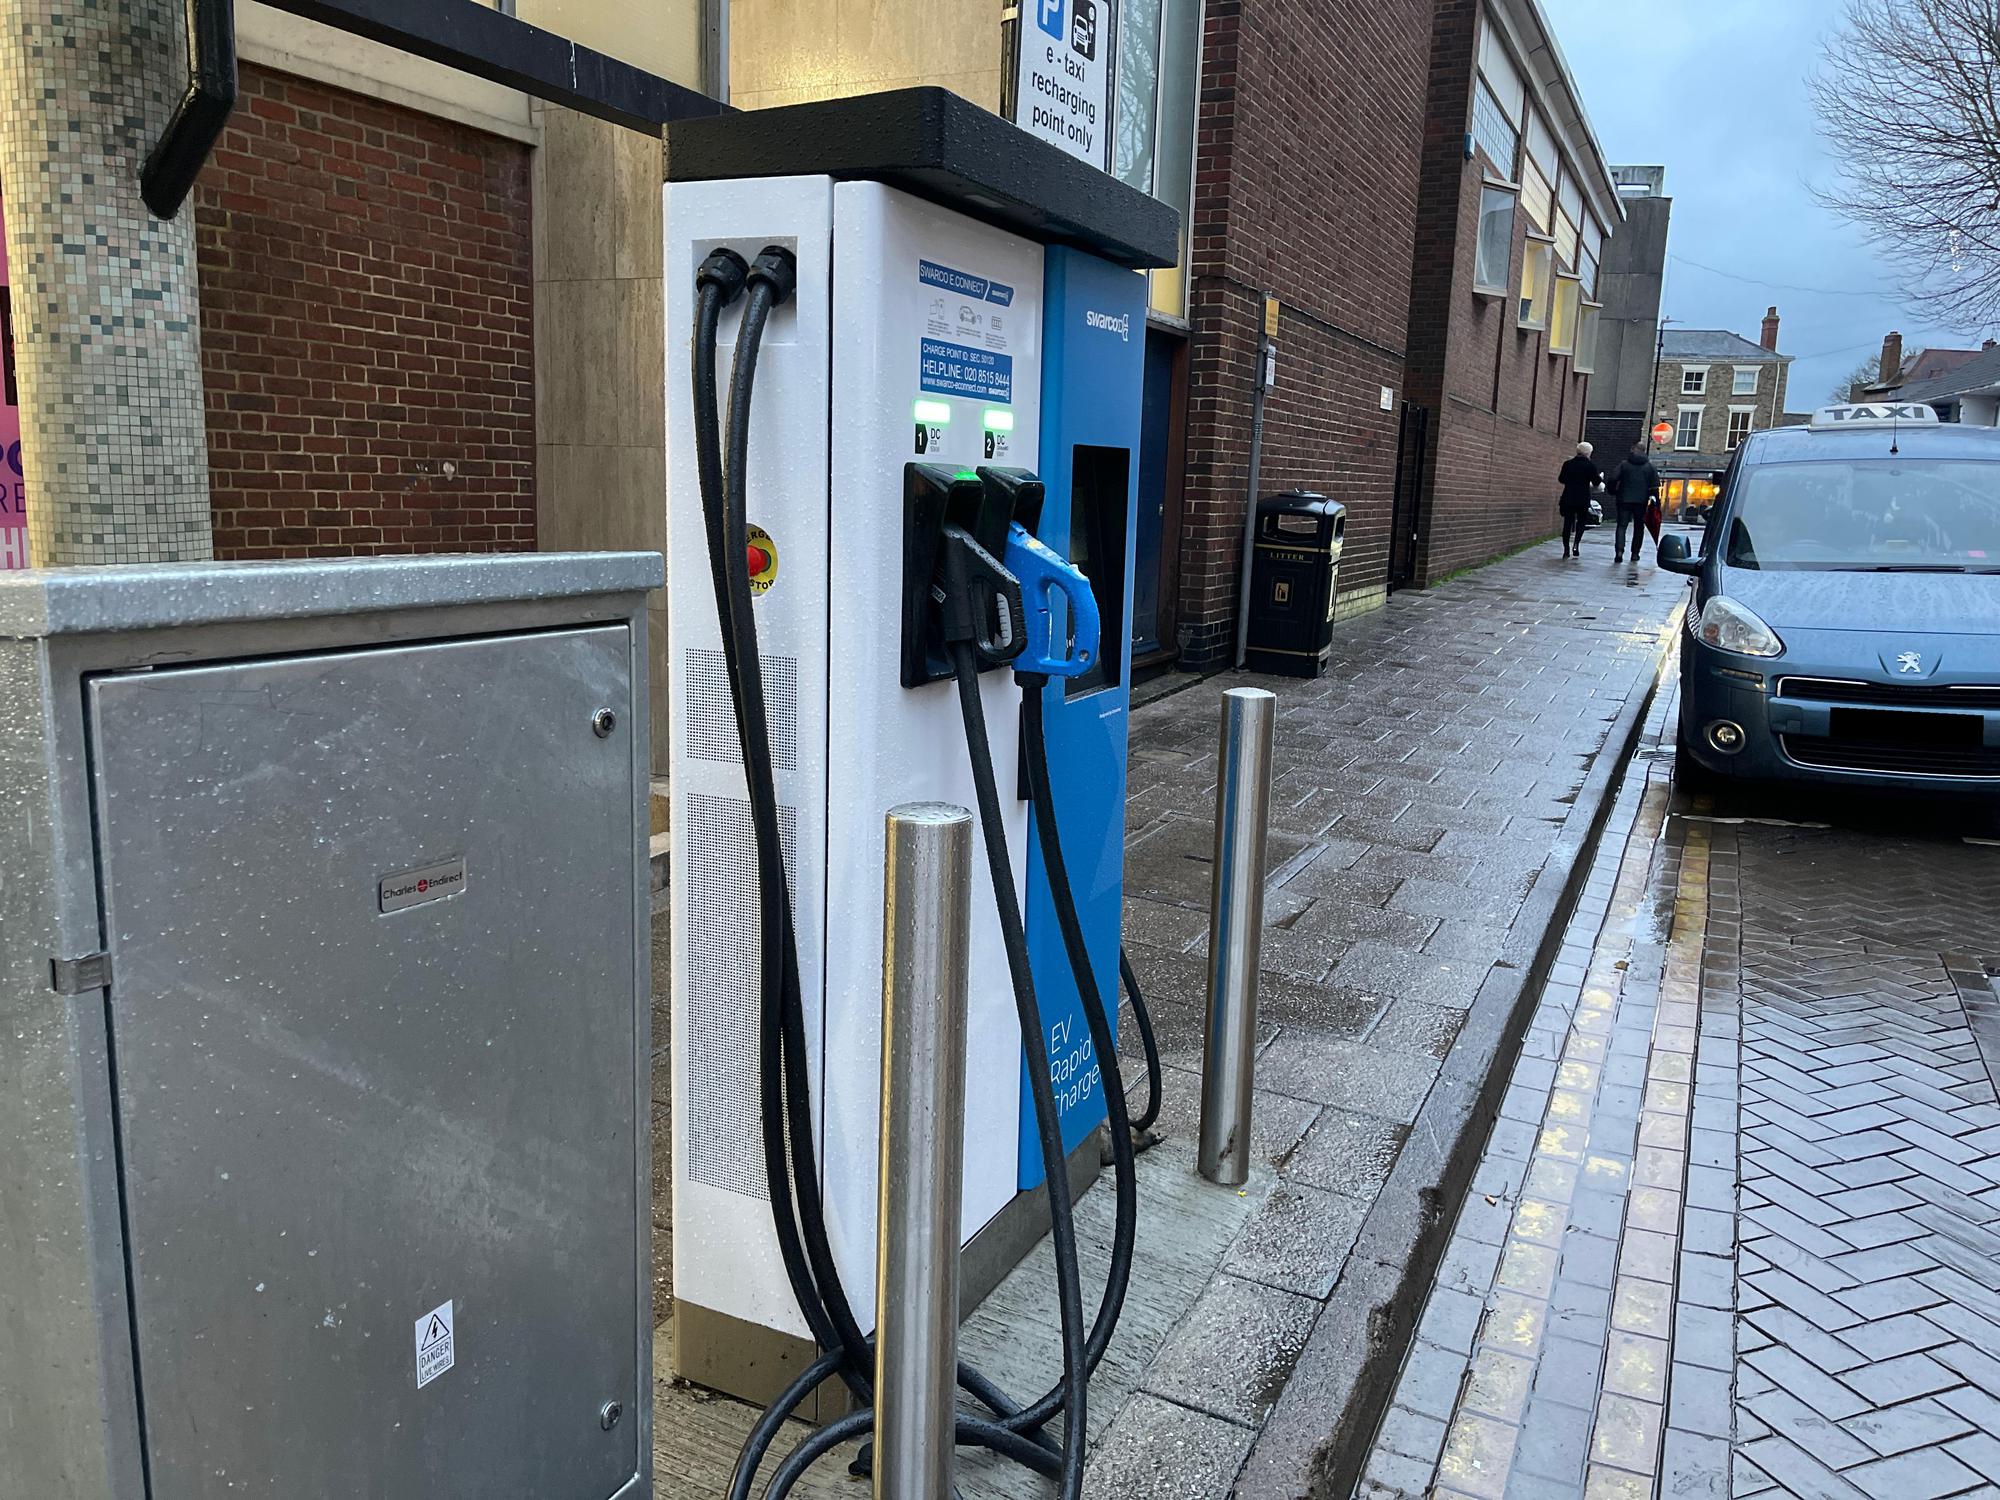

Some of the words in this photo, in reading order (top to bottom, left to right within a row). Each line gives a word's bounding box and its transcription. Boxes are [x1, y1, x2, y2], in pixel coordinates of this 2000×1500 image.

[1046, 46, 1054, 63] e
[1064, 53, 1085, 83] taxi
[1032, 71, 1096, 125] recharging
[1032, 105, 1065, 136] point
[1067, 124, 1093, 153] only
[920, 264, 949, 285] SWARCO
[923, 343, 946, 357] CHARGE
[946, 347, 962, 360] POINT
[923, 358, 962, 380] HELPLINE:
[964, 366, 977, 382] 020
[978, 370, 994, 385] 8515
[995, 373, 1010, 388] 8444
[1825, 406, 1924, 421] TAXI
[918, 432, 923, 447] 1
[931, 428, 941, 440] DC
[986, 438, 992, 452] 2
[1270, 551, 1305, 561] LITTER
[749, 579, 774, 590] STOP
[383, 884, 417, 899] Charles
[428, 871, 462, 888] Endirect
[1051, 1013, 1072, 1055] EV
[1051, 1034, 1092, 1085] Rapid
[1054, 1064, 1100, 1118] harge
[421, 1341, 450, 1369] DANGER
[421, 1365, 433, 1380] LIVE
[433, 1355, 450, 1372] WIRES
